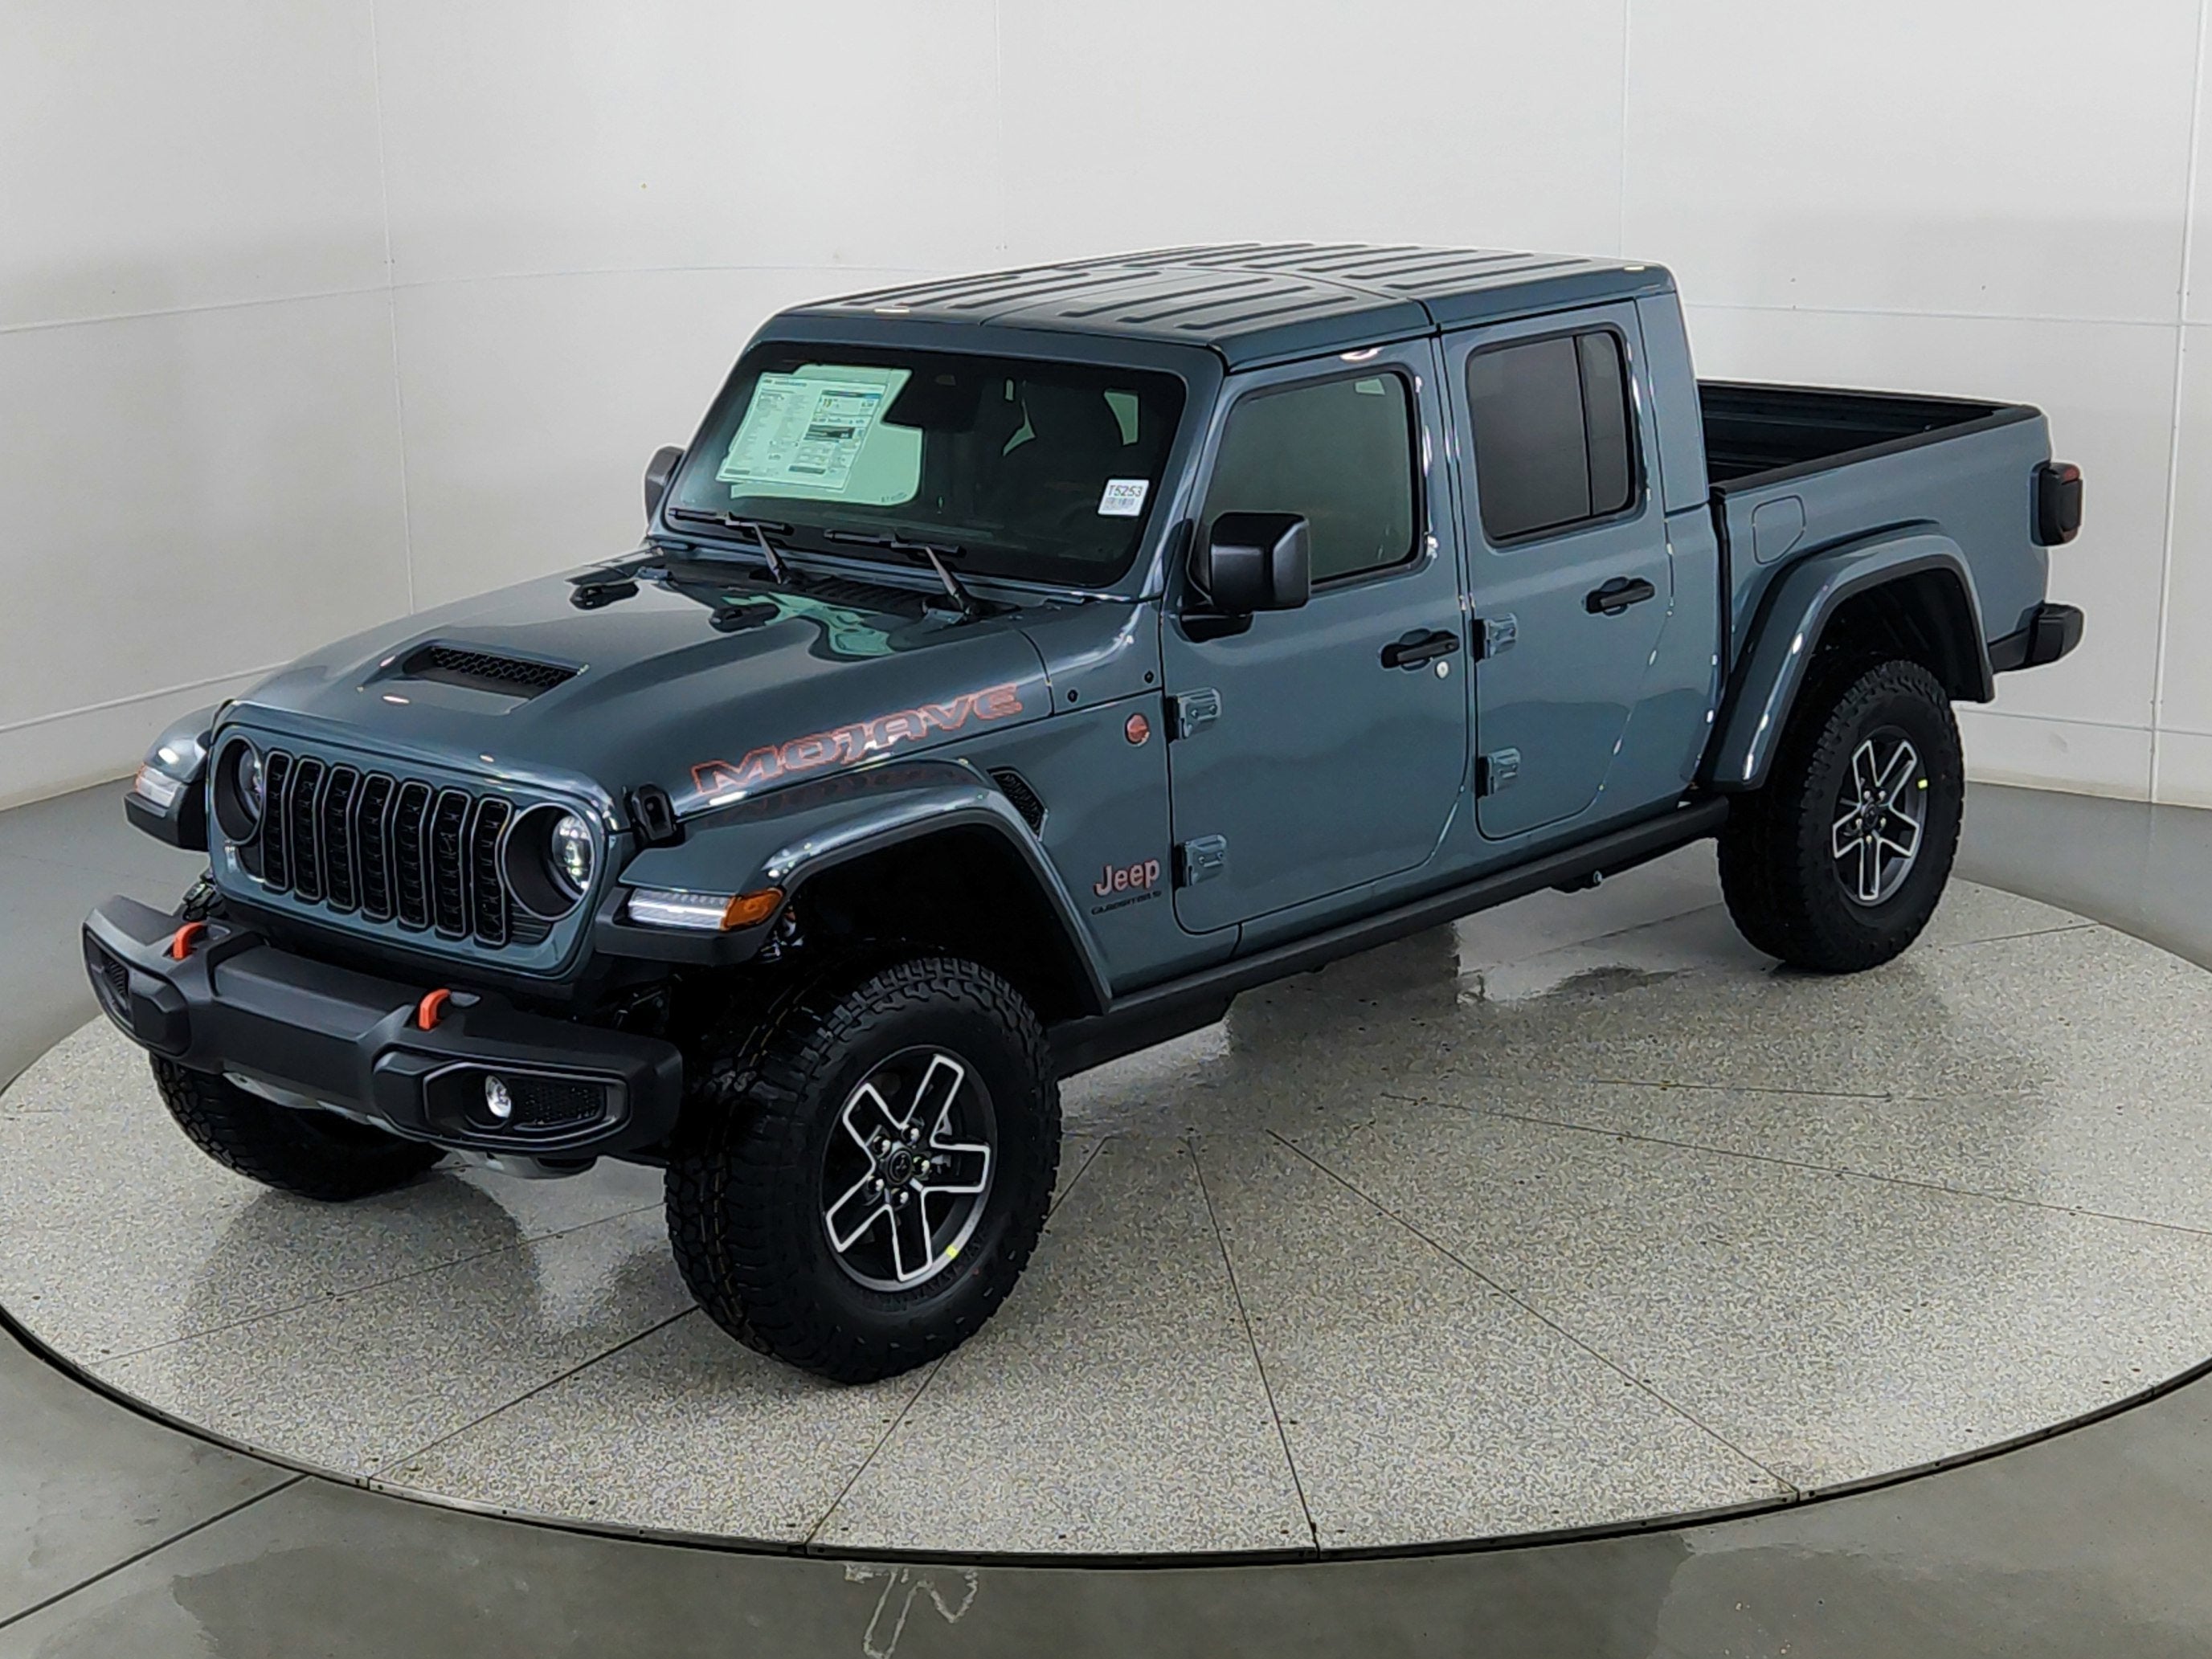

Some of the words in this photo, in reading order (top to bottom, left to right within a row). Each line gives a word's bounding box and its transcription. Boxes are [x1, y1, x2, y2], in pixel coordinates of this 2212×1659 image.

[1108, 484, 1143, 497] T5253
[690, 684, 1023, 794] MOJAVE
[1094, 859, 1159, 897] Jeep
